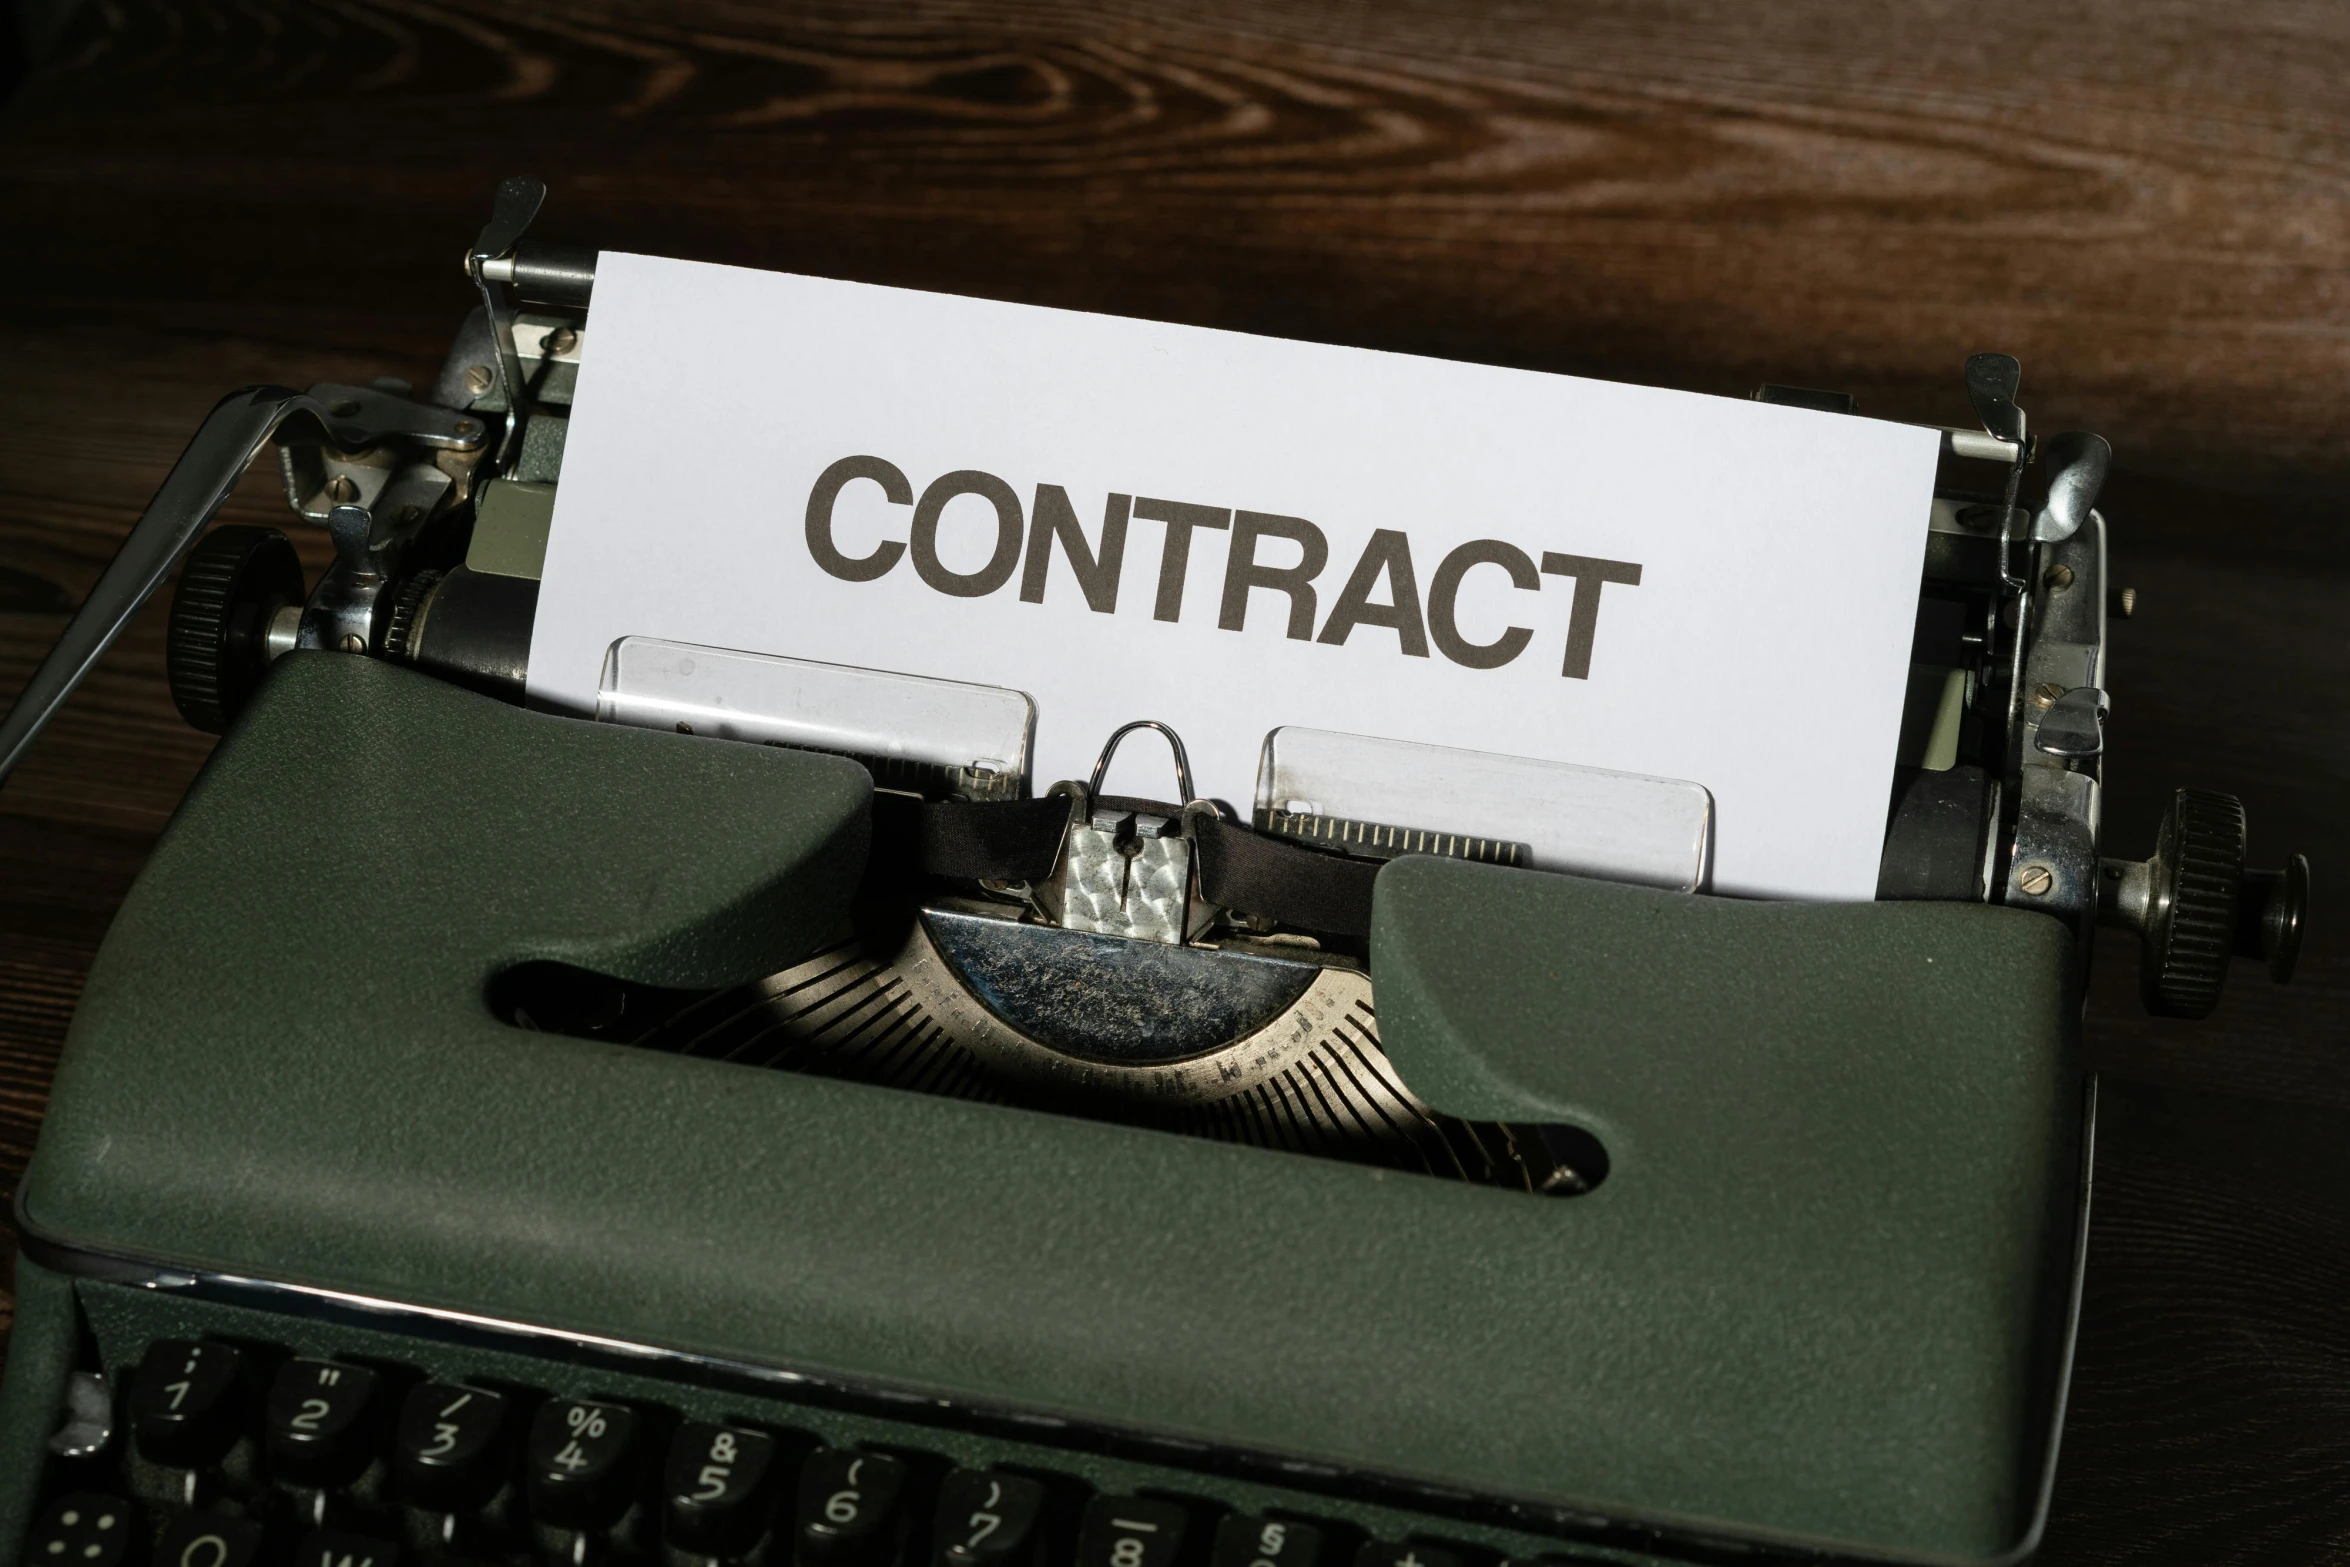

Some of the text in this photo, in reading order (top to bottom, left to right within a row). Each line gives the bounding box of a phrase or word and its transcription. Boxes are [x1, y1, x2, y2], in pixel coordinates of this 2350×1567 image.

[804, 454, 1643, 681] CONTRACT
[164, 1381, 191, 1410] 1
[291, 1399, 330, 1430] 2
[566, 1406, 607, 1439] %
[420, 1422, 459, 1456] 3
[553, 1440, 588, 1471] 4
[709, 1432, 738, 1464] &
[691, 1465, 730, 1500] 5
[825, 1490, 860, 1523] 6
[968, 1512, 1001, 1548] 7
[1109, 1537, 1145, 1567] 8
